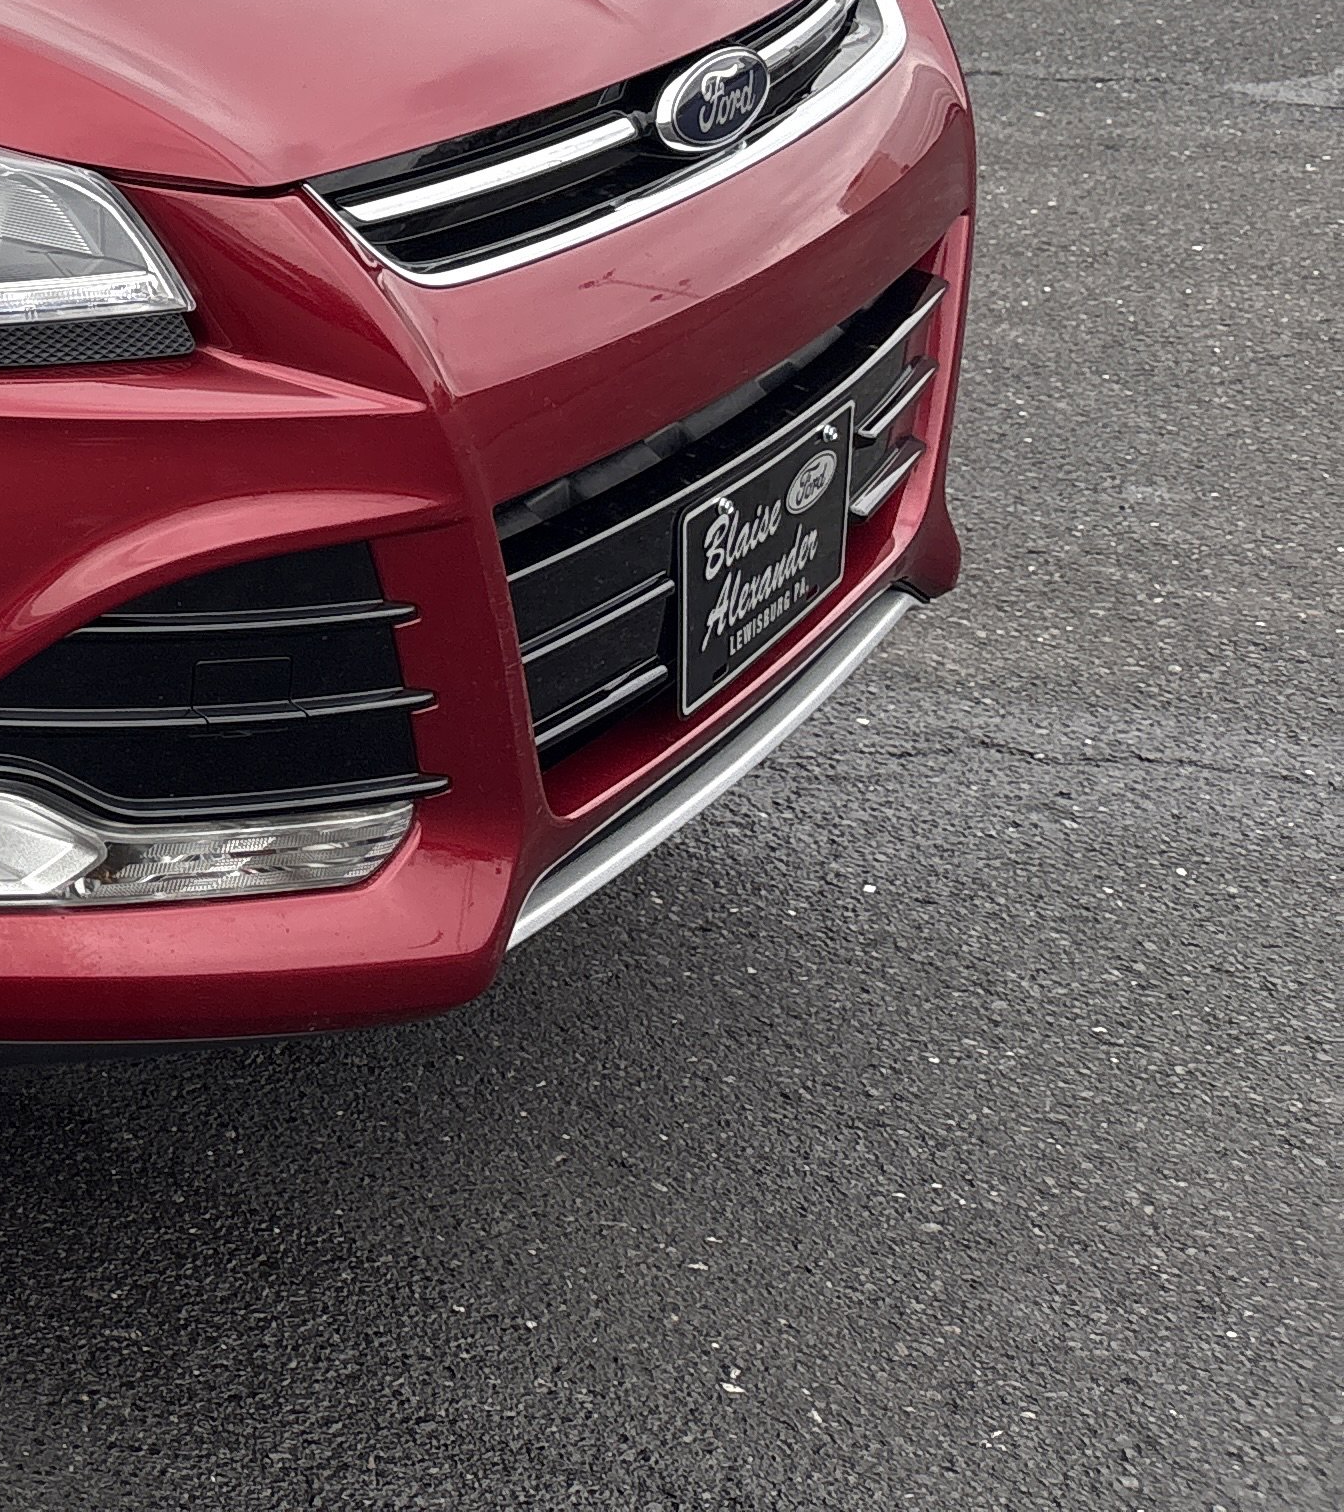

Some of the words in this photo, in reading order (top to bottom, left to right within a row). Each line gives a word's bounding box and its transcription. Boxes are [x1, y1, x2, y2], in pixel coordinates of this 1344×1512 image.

[698, 63, 758, 134] Ford
[795, 461, 828, 507] Ford
[703, 499, 782, 581] Blaise
[701, 523, 818, 653] Alexander
[729, 590, 791, 656] LEWISBURG
